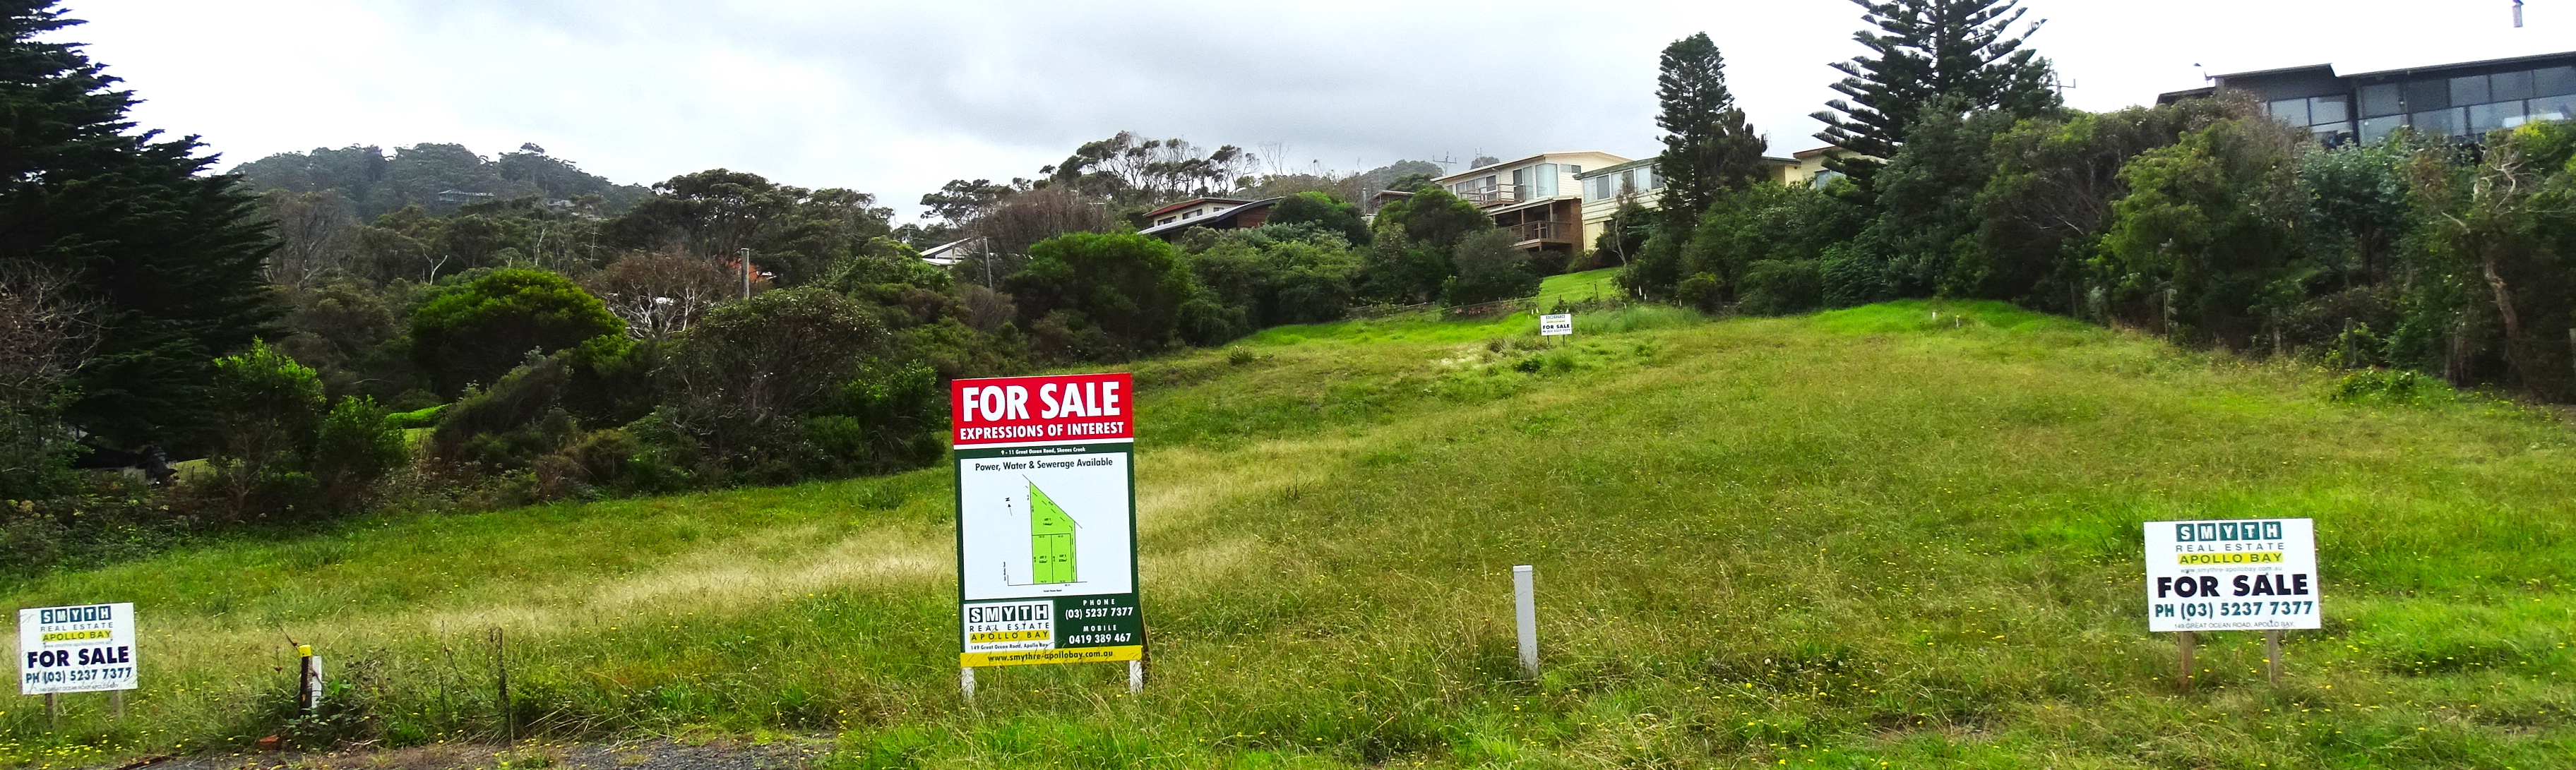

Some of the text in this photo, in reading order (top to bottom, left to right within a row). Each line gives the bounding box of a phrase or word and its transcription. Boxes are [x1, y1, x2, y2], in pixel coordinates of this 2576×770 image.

[962, 381, 1120, 421] FOR SALE
[960, 421, 1123, 440] EXPRESSIONS OF INTEREST
[975, 463, 1001, 471] Power,
[1003, 462, 1026, 470] Water
[1037, 460, 1074, 469] Sewerage
[1077, 457, 1113, 467] Available
[2181, 523, 2279, 540] SMYTH
[2179, 553, 2282, 564] APOLLO BAY
[2157, 574, 2308, 598] FOR SALE
[43, 608, 109, 622] SMYTH
[971, 606, 1048, 622] SMYTH
[1065, 606, 1133, 620] (03) 5237 7377
[2155, 601, 2313, 620] PH (03) 5237 7377
[73, 622, 113, 630] ESTATE
[1008, 622, 1049, 630] ESTATE
[42, 630, 112, 642] APOLLO BAY
[1069, 633, 1131, 644] 0419 389 467
[28, 646, 129, 668] FOR SALE
[988, 650, 1113, 662] www.smythre-apollobay.com.au
[26, 667, 132, 685] PH (03) 5237 7377
